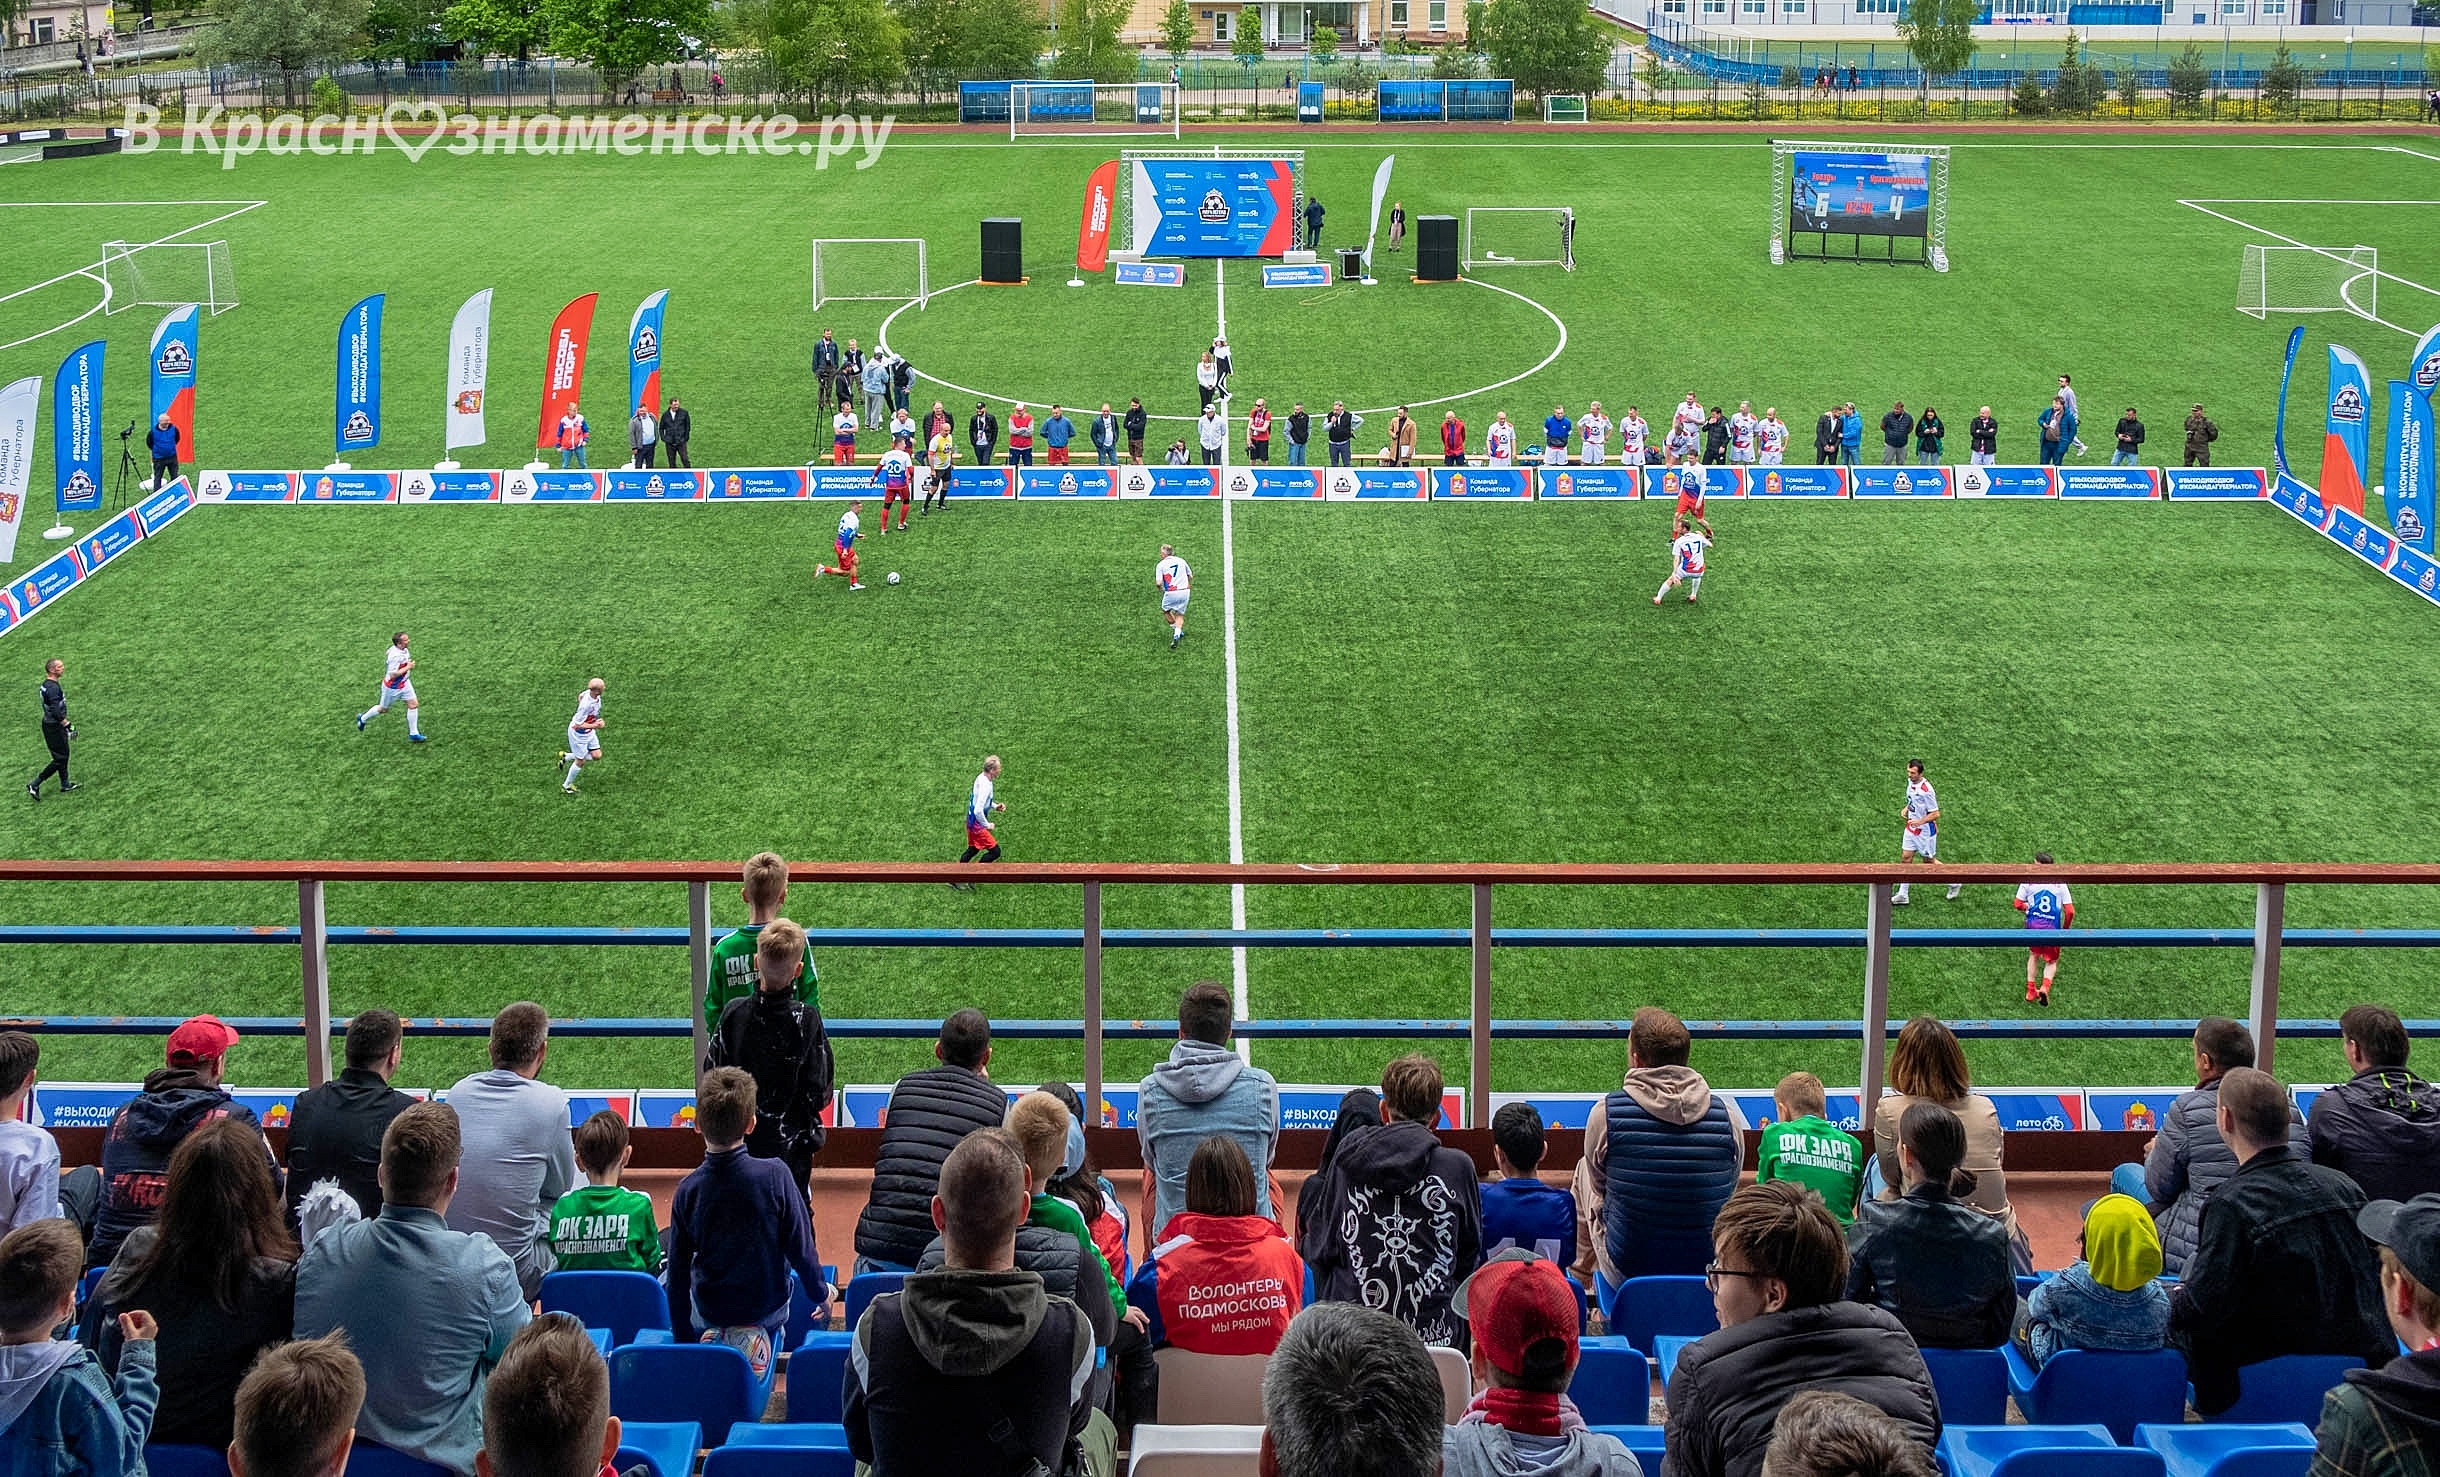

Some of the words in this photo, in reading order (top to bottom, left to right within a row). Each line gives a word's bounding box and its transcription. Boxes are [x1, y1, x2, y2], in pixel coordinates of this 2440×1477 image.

[1815, 193, 1830, 217] 6
[1890, 196, 1904, 220] 4
[462, 345, 470, 385] Команда
[472, 326, 483, 384] Губернатора
[562, 341, 578, 390] СПОРТ
[80, 353, 90, 461] #КОМАНДАГУБЕРНАТОРА
[71, 385, 81, 461] #ВЫХОДИВОДВОР
[10, 419, 24, 486] Губернатора
[887, 463, 901, 474] 20
[1470, 485, 1511, 493] Губернатора
[1576, 485, 1617, 493] Губернатора
[1685, 540, 1701, 555] 17
[1169, 564, 1178, 577] 7
[2038, 895, 2051, 912] 8
[1779, 1133, 1807, 1153] ФК
[1810, 1136, 1852, 1162] ЗАРЯ
[556, 1216, 582, 1240] ФК
[583, 1214, 630, 1240] ЗАРЯ
[555, 1238, 628, 1254] КРАСНОЗНАМЕНСК
[1211, 1322, 1230, 1334] МЫ
[1232, 1317, 1271, 1330] РЯДОМ
